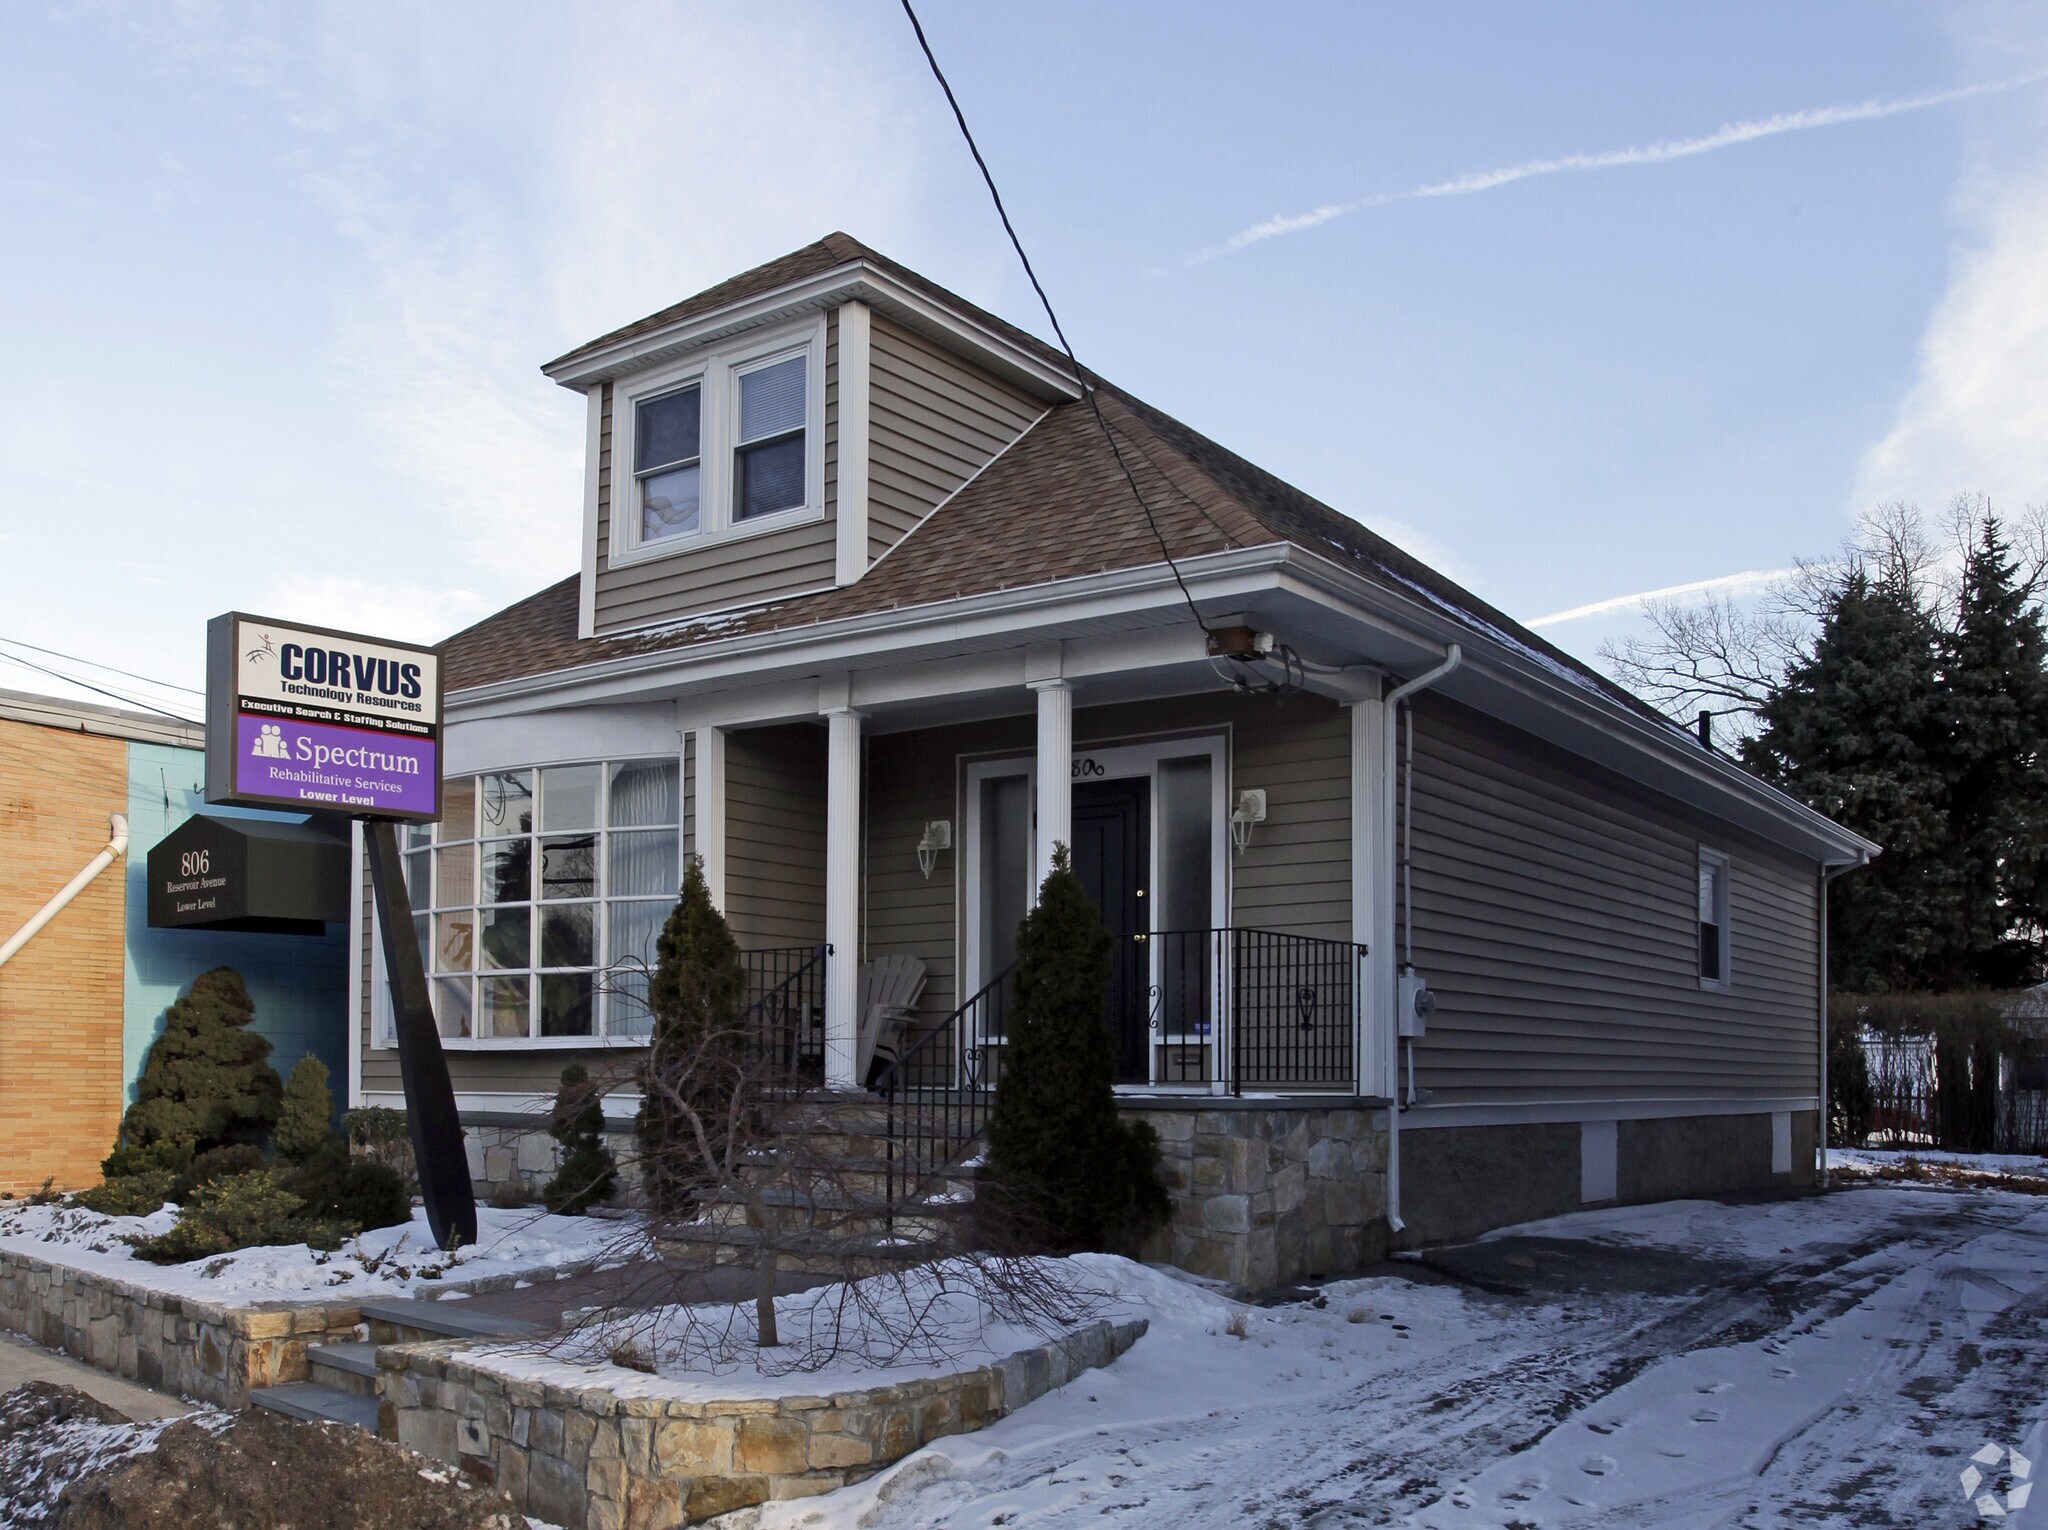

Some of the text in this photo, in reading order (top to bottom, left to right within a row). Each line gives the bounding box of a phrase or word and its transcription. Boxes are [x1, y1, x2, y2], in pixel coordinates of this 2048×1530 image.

[280, 643, 421, 699] CORVUS
[280, 680, 422, 713] Technology Resources
[241, 699, 429, 734] Executive Search & Staffing Solutions
[296, 736, 419, 775] Spectrum
[1071, 758, 1105, 777] 806
[269, 766, 403, 793] Rehabilitative Services
[300, 788, 375, 806] Lower Level
[181, 849, 209, 877] 806
[167, 877, 226, 893] Reservoir Avenue
[177, 897, 215, 912] Lower Level
